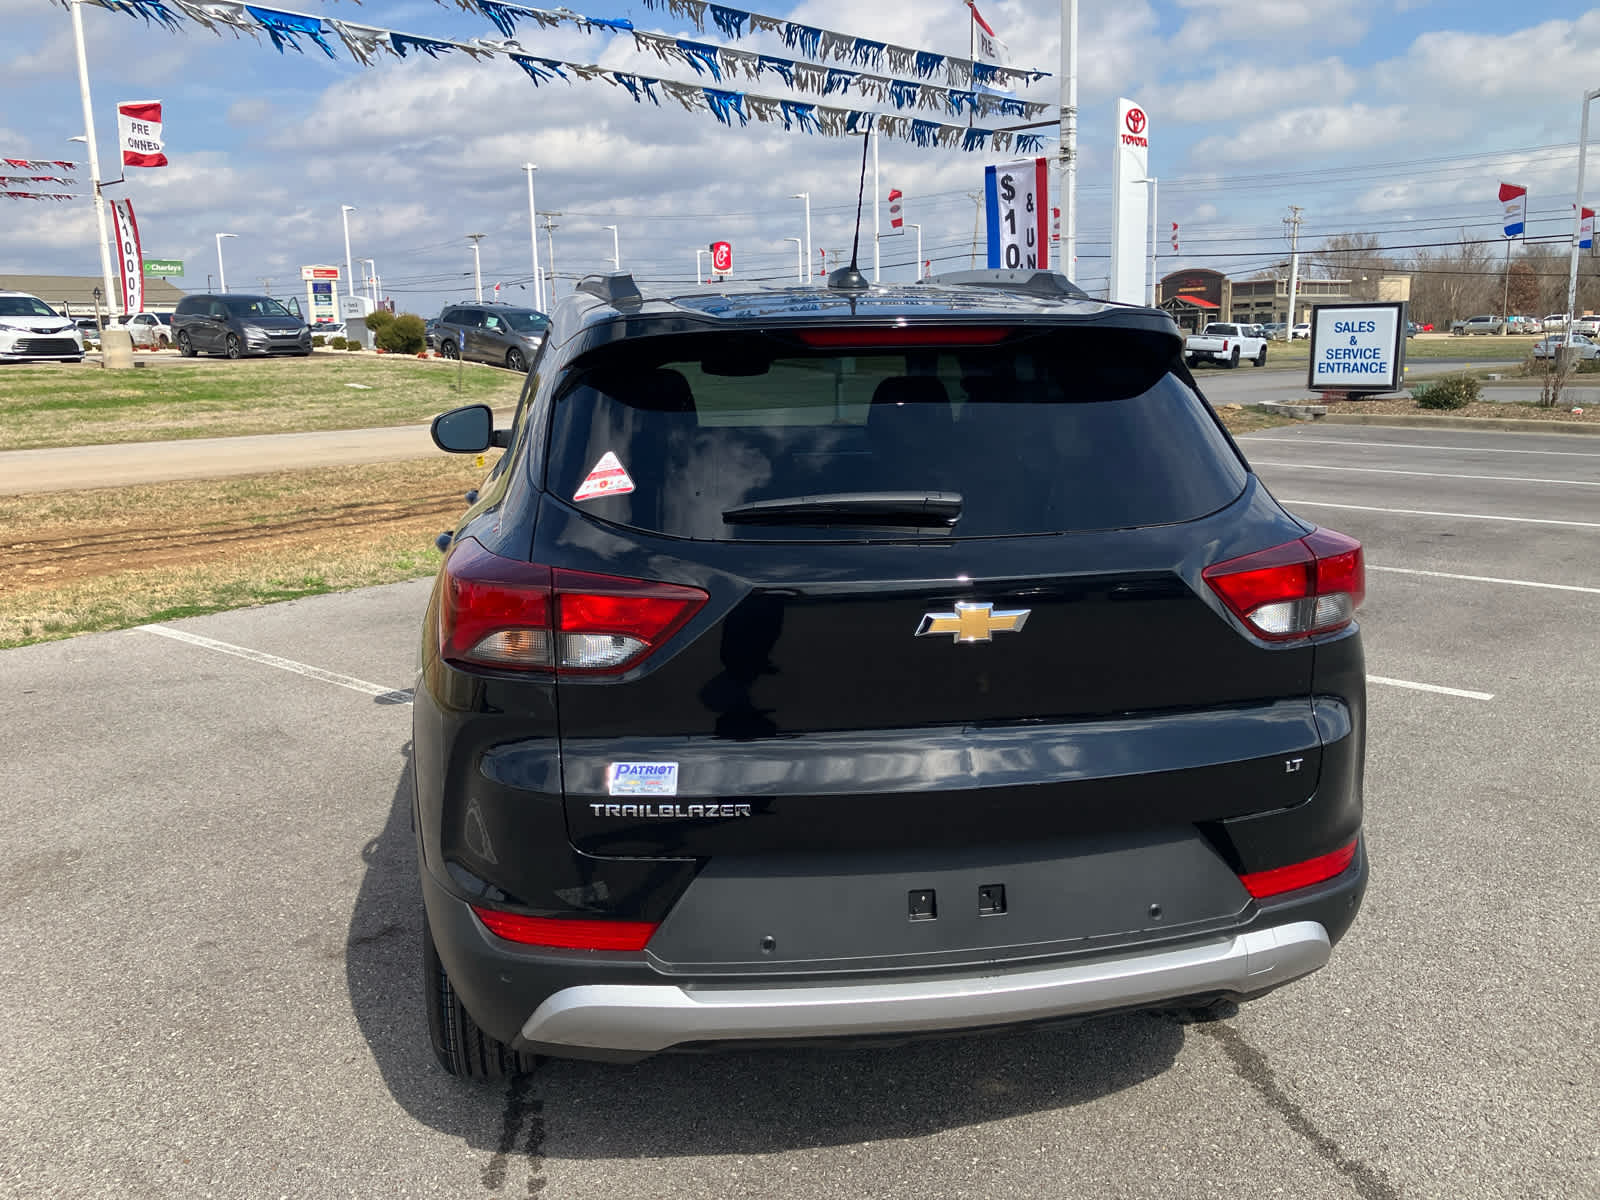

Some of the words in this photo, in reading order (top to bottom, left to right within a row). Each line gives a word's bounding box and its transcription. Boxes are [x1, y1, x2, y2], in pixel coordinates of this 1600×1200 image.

[131, 121, 150, 136] PRE
[127, 137, 161, 152] OWNED
[1121, 134, 1148, 147] TOYOTA
[1334, 321, 1376, 333] SALES
[1349, 335, 1358, 346] &
[1326, 348, 1381, 360] SERVICE
[1318, 361, 1387, 374] ENTRANCE
[614, 763, 675, 780] PATRIOT
[1286, 758, 1304, 773] LT
[589, 803, 751, 818] TRAILBLAZER
